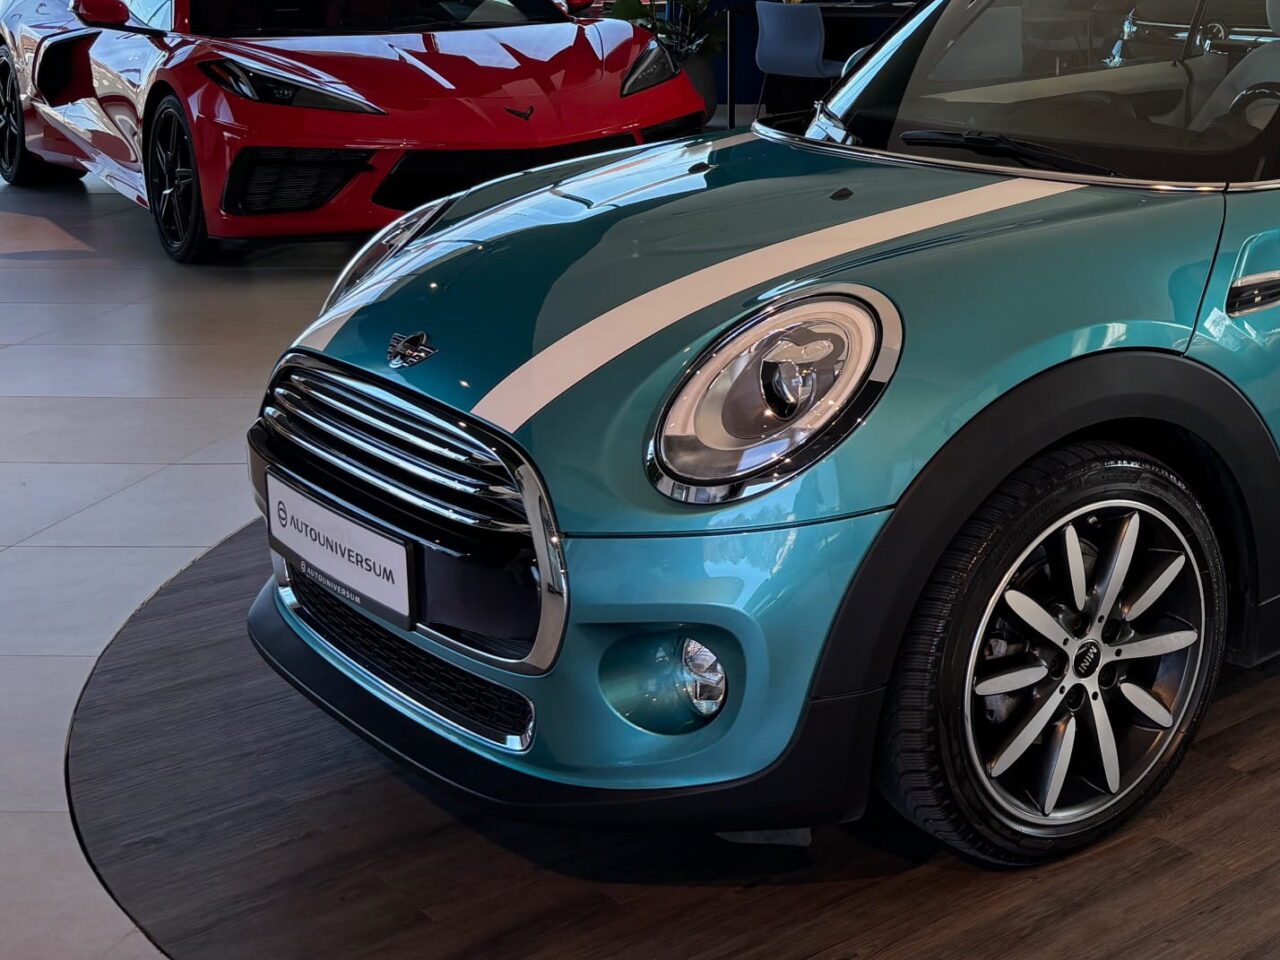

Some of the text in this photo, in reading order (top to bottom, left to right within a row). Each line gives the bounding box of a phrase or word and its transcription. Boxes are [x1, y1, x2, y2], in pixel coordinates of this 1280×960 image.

[289, 515, 396, 585] AUTOUNIVERSUM
[306, 567, 362, 605] AUTOUNIVERSUM
[1078, 645, 1098, 674] MINI
